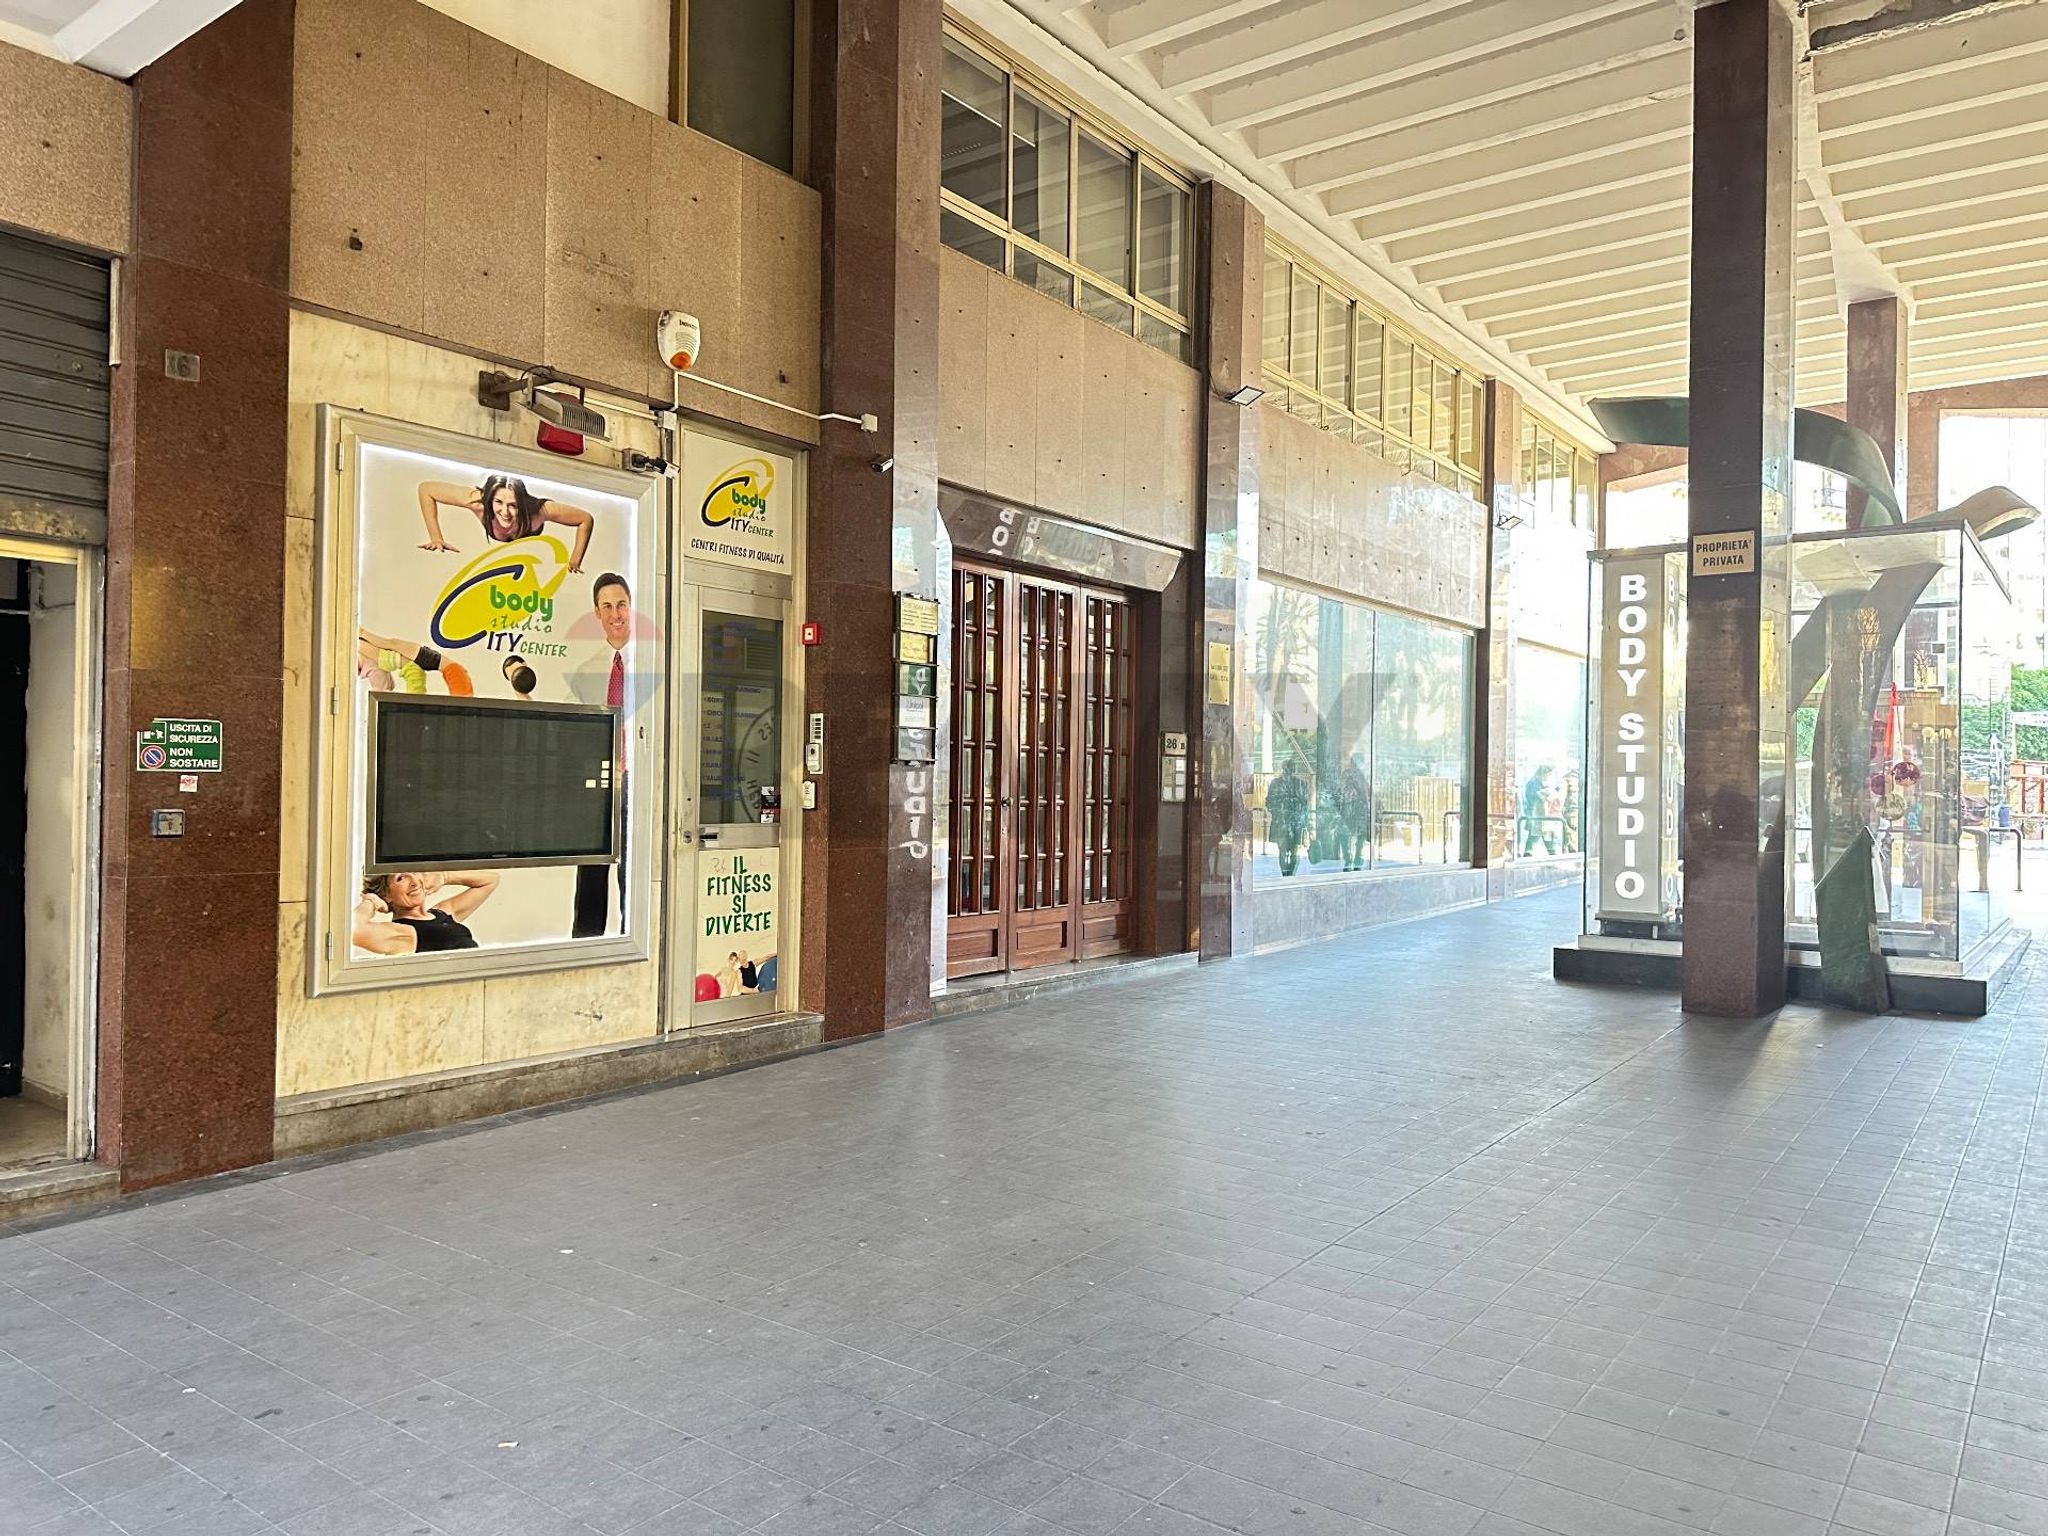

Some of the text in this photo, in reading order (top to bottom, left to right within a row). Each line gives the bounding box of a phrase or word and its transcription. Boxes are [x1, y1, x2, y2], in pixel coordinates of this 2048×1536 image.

[732, 488, 766, 514] body
[733, 508, 766, 522] studio
[748, 525, 774, 538] CENTER
[691, 538, 717, 552] CENTRI
[718, 544, 747, 558] FITNESS
[748, 549, 756, 559] DI
[1696, 539, 1752, 553] PROPRIETA'
[1703, 554, 1744, 567] PRIVATA
[490, 585, 553, 622] body
[490, 614, 552, 633] studio
[519, 640, 568, 657] CENTER
[169, 723, 212, 733] USCITA DI
[169, 734, 218, 743] SICUREZZA
[1166, 738, 1177, 750] 26
[1614, 574, 1648, 900] BODY STUDIO
[169, 747, 193, 757] NON
[169, 759, 218, 768] SOSTARE
[733, 855, 748, 874] IL
[707, 873, 772, 896] FITNESS
[732, 894, 747, 914] SI
[705, 911, 772, 937] DIVERTE
